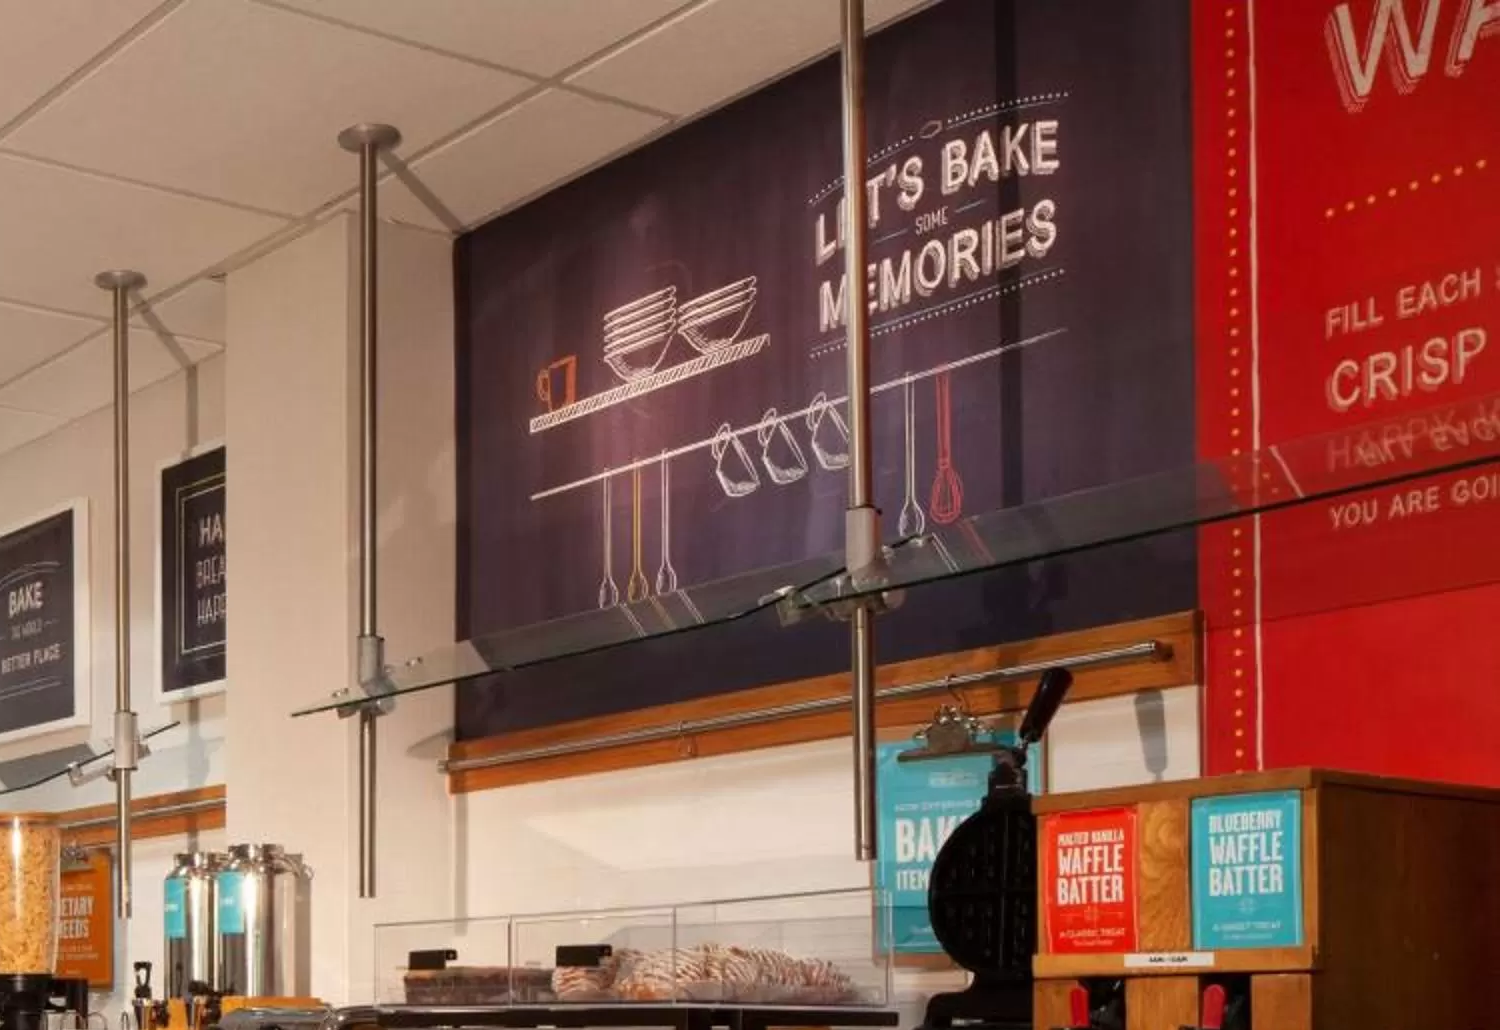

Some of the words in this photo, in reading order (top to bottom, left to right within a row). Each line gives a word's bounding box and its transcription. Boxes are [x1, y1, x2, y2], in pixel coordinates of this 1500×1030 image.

[814, 155, 925, 267] LT'S
[941, 119, 1061, 196] BAKE
[914, 205, 950, 237] SOME
[818, 198, 1058, 333] MEMORIES
[1325, 297, 1384, 341] FILL
[1396, 267, 1482, 320] EACH
[1325, 326, 1487, 413] CRISP
[1329, 496, 1378, 531] YOU
[1388, 485, 1441, 522] ARE
[8, 580, 43, 619] BAKE
[895, 815, 971, 863] BAK
[1208, 809, 1283, 833] BLUEBERRY
[1057, 844, 1125, 876] WAFFLE
[1209, 832, 1284, 864] WAFFLE
[1057, 875, 1125, 906] BATTER
[1209, 864, 1284, 897] BATTER
[61, 895, 95, 917] ETARY
